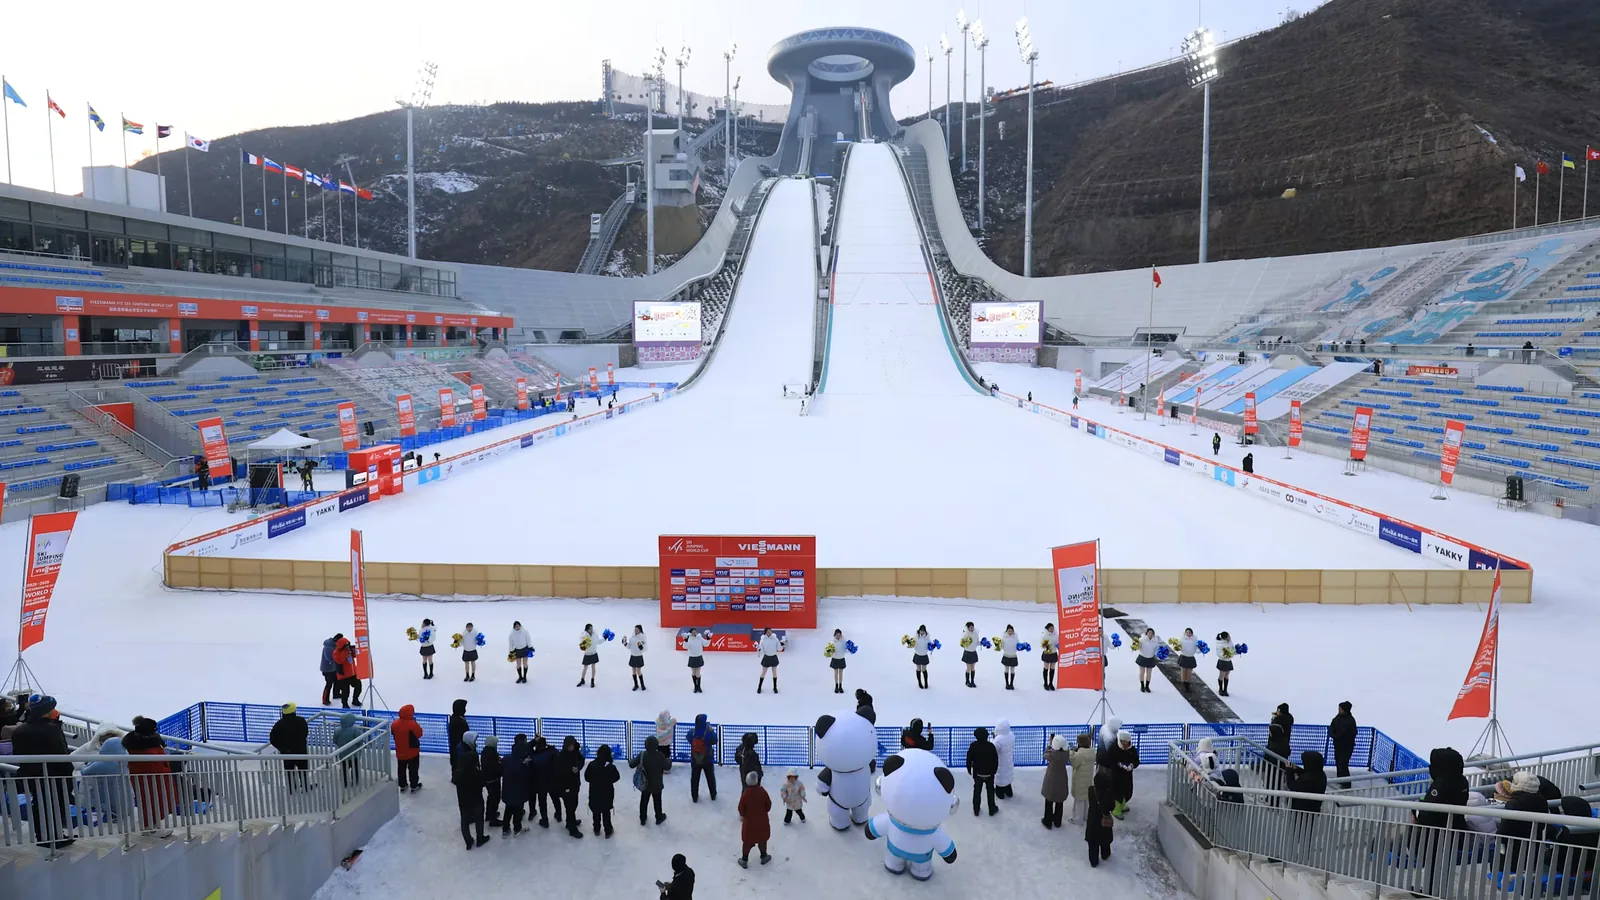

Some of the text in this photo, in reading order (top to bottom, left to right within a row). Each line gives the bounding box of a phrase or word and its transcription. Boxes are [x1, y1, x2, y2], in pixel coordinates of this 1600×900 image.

[316, 504, 336, 516] YAKKY
[738, 540, 800, 554] VIESSMANN
[1434, 545, 1463, 562] YAKKY
[36, 553, 64, 562] JUMPING
